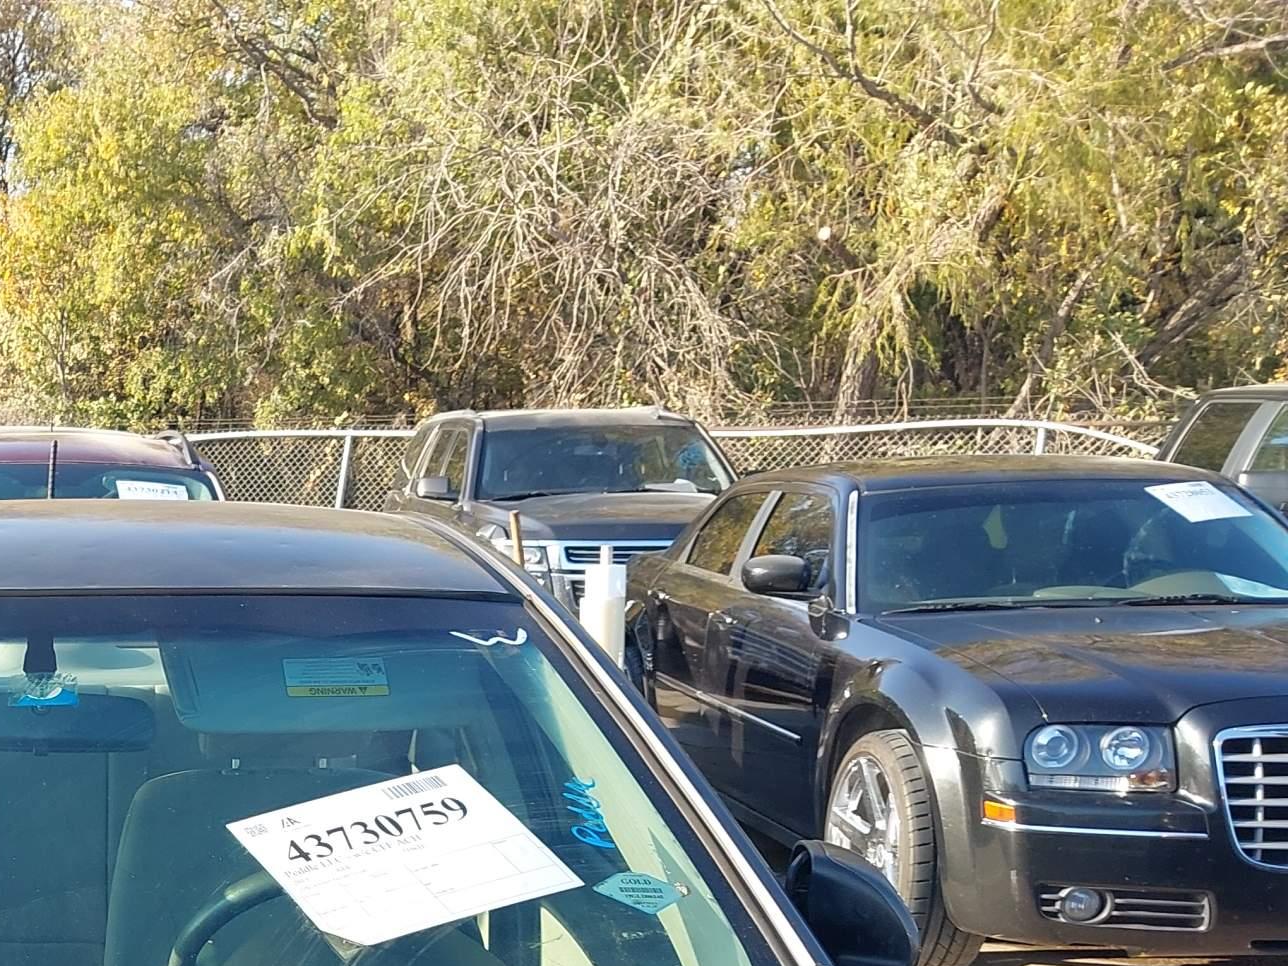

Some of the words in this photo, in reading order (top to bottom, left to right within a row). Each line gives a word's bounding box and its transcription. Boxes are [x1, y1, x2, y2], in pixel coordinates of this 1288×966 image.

[308, 687, 357, 695] WARNING
[287, 797, 468, 862] 43730759
[620, 878, 652, 886] GOLD
